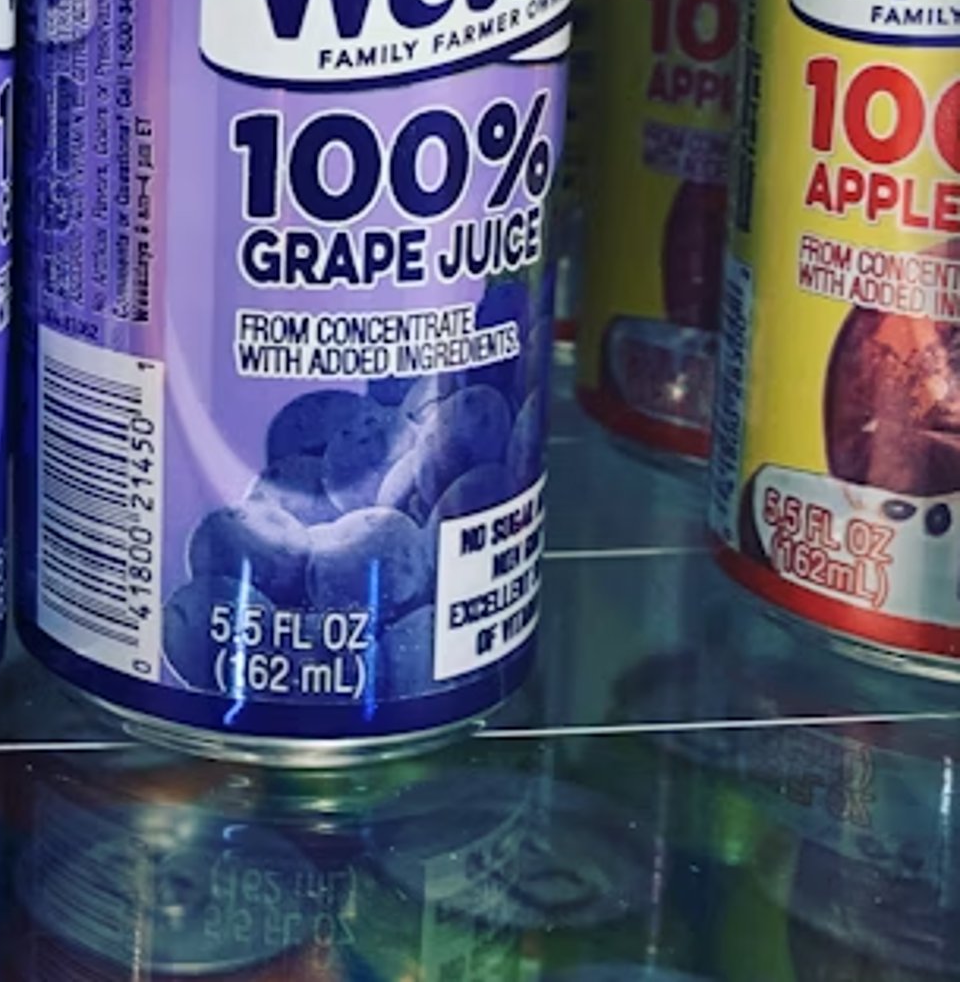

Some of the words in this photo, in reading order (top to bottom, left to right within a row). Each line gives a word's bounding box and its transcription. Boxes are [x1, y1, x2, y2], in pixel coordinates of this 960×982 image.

[318, 39, 420, 72] FAMILY
[433, 8, 521, 55] FARMER
[233, 89, 550, 225] 100%
[241, 227, 429, 287] GRAPE
[439, 206, 542, 282] JUICE
[800, 235, 851, 268] FROM
[799, 263, 845, 298] WITH
[849, 275, 926, 314] ADDED
[238, 312, 311, 346] FROM
[316, 306, 477, 346] CONCENTRATE
[238, 342, 302, 375] WITH
[307, 342, 392, 376] ADDED
[131, 418, 155, 512] 21450
[806, 504, 840, 549] FL
[847, 519, 895, 564] OZ
[129, 526, 153, 619] 41800
[772, 531, 888, 608] (162mL)
[272, 611, 313, 650] FL
[322, 612, 370, 650] OZ
[300, 654, 369, 700] mL)
